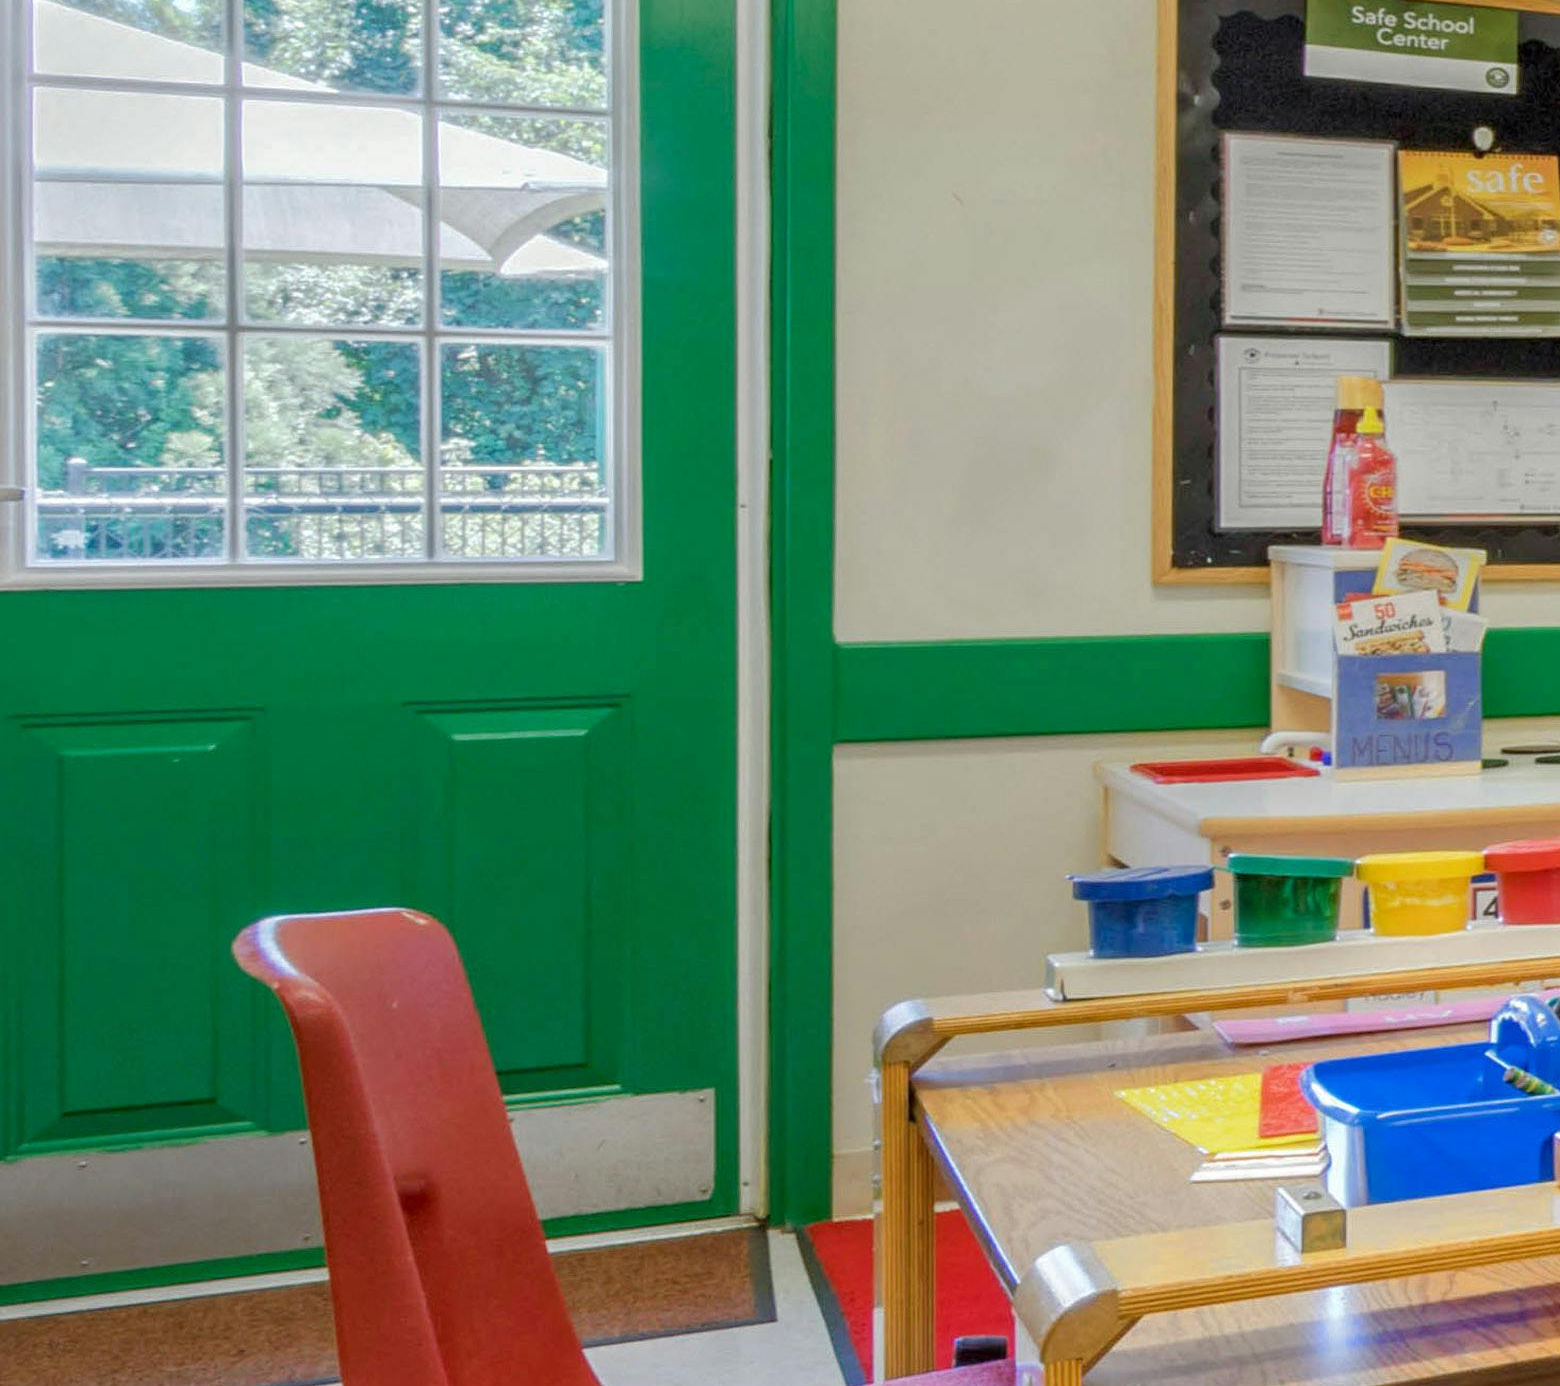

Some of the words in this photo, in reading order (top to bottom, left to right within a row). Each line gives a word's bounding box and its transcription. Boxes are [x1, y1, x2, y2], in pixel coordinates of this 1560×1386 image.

[1351, 5, 1398, 28] Safe
[1403, 11, 1475, 34] School
[1375, 27, 1450, 50] Center
[1466, 163, 1545, 195] safe
[1374, 601, 1397, 621] 50
[1342, 613, 1434, 642] Sandwiches
[1351, 731, 1454, 765] MENUS
[1483, 896, 1498, 918] 4
